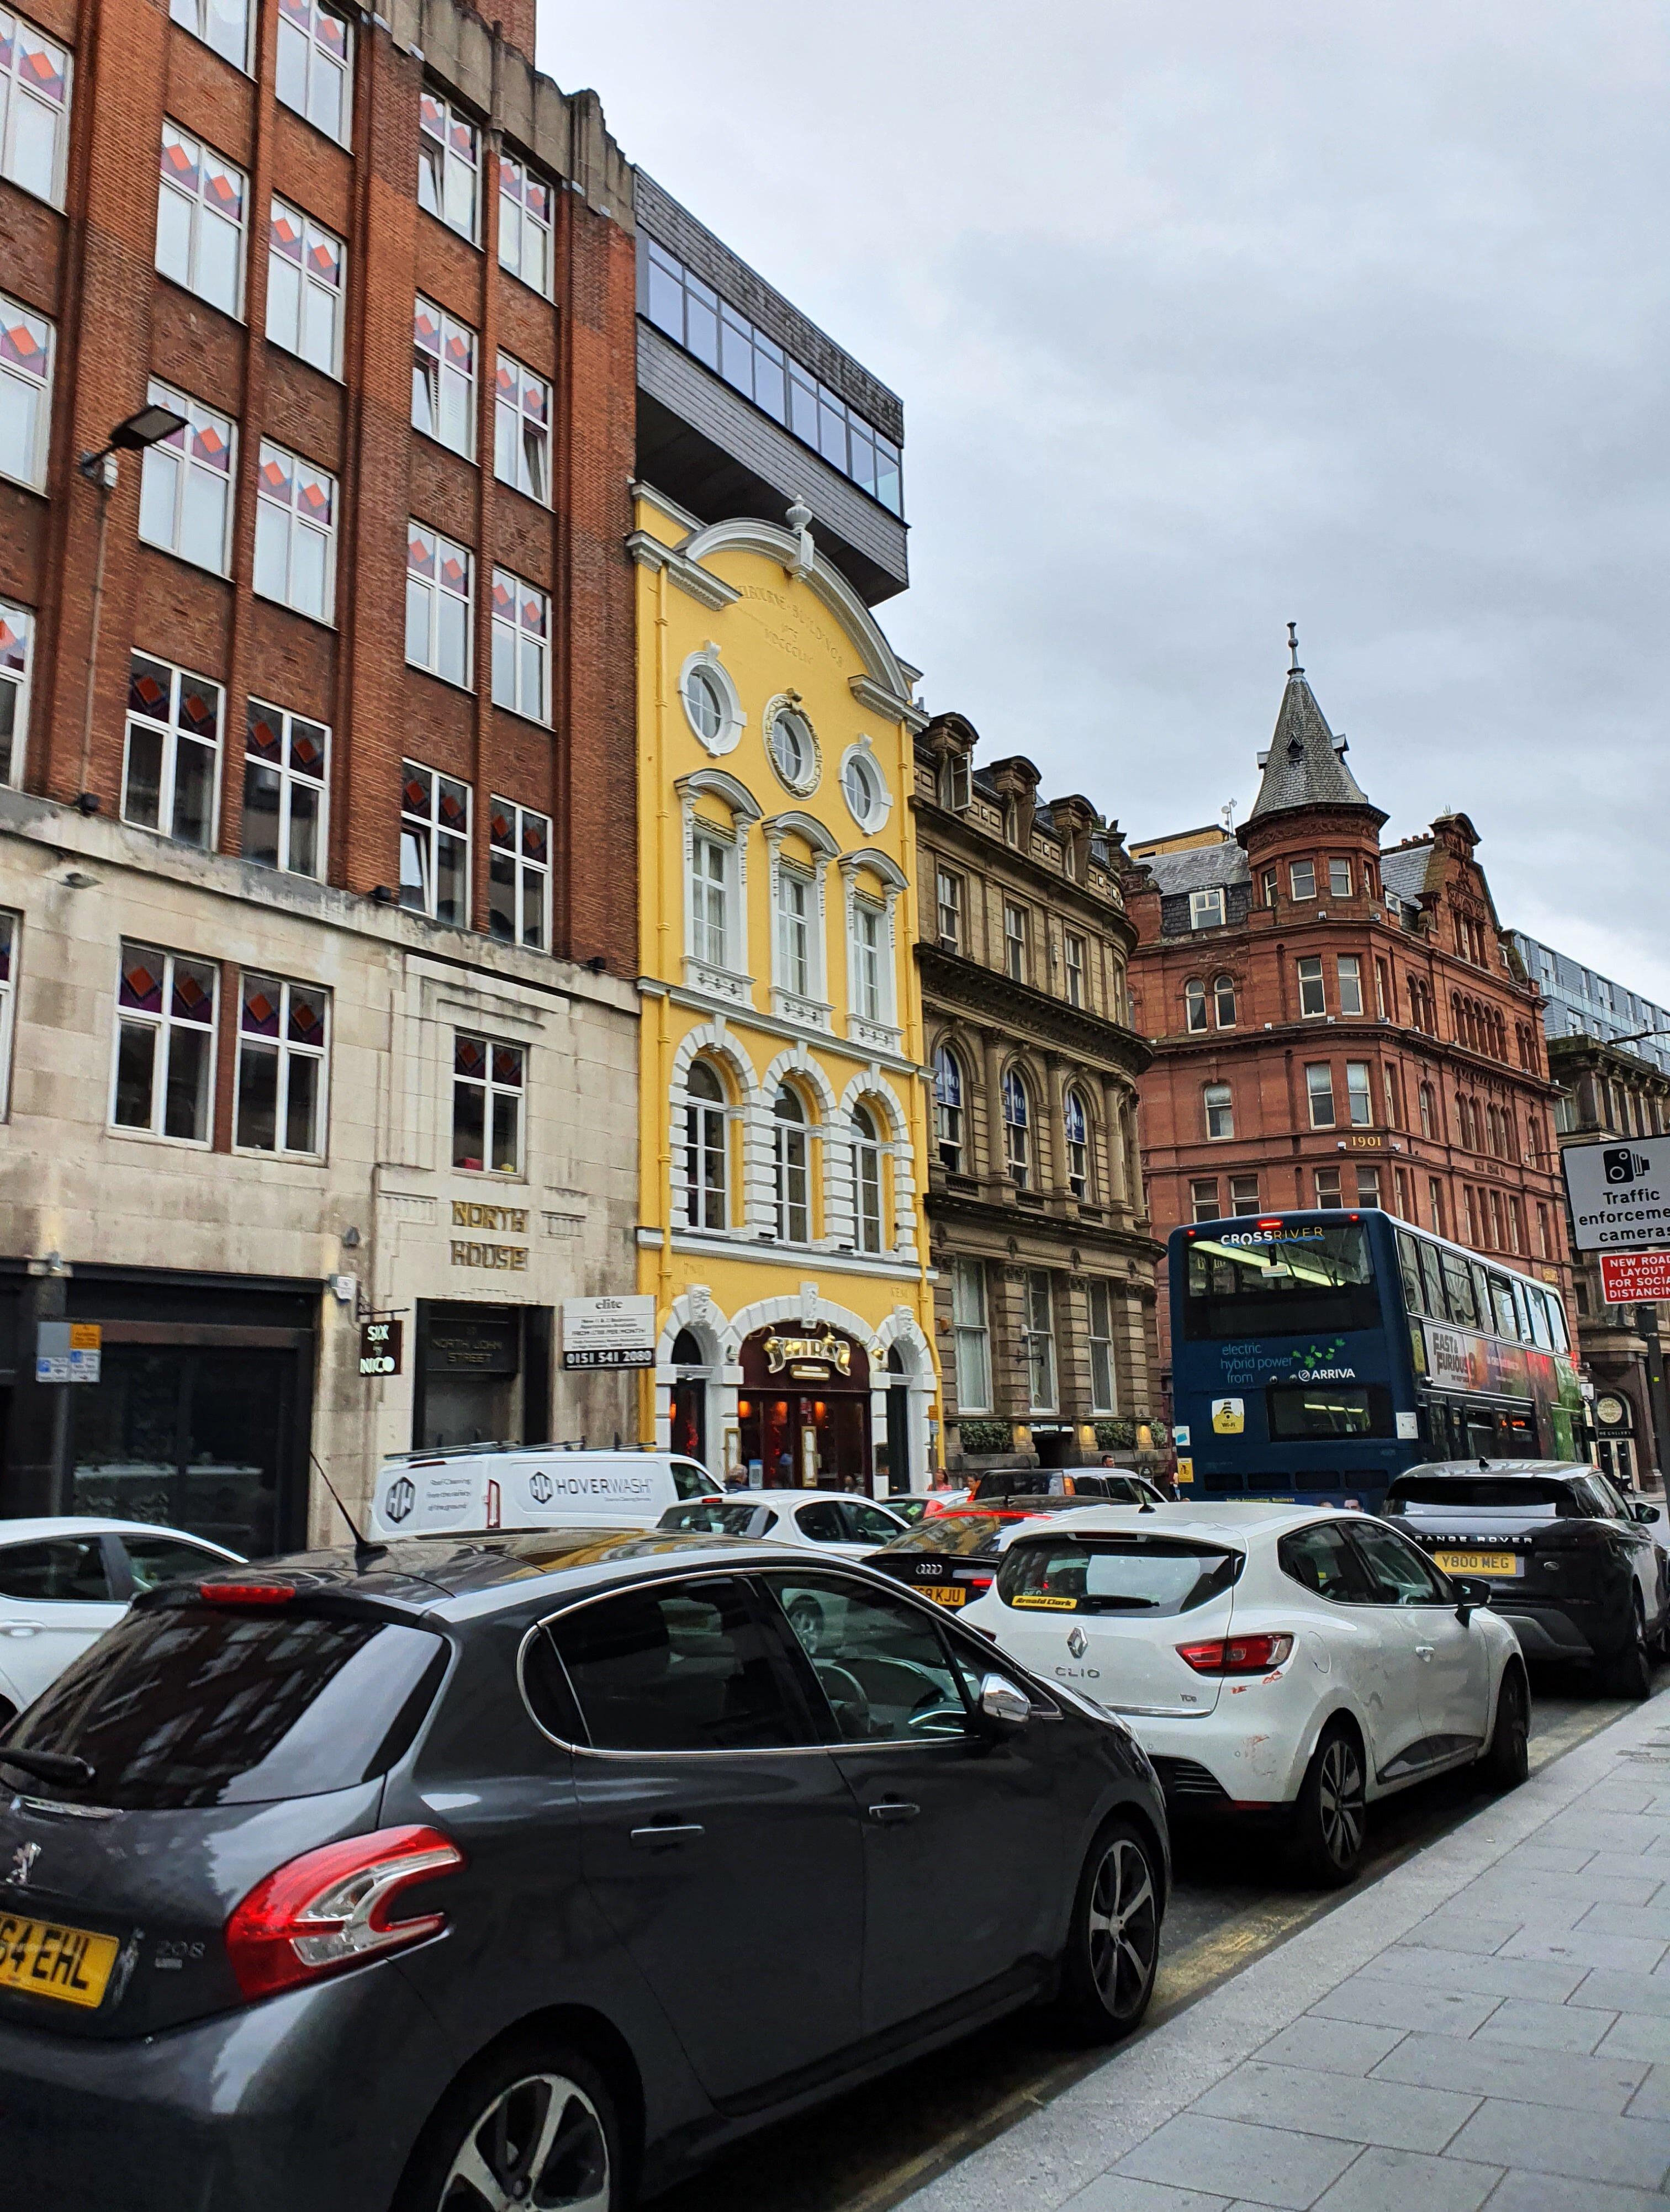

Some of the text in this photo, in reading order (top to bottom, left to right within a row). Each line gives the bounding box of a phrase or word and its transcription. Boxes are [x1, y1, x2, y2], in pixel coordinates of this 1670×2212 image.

[1352, 1136, 1381, 1147] 1901
[1603, 1188, 1660, 1205] Traffic
[452, 1201, 527, 1232] NORTH
[451, 1241, 528, 1271] HOUSE
[1610, 1257, 1636, 1267] NEW
[1620, 1266, 1664, 1277] LAYOUT
[1609, 1278, 1631, 1288] FOR
[367, 1325, 389, 1341] SIX
[1222, 1342, 1262, 1355] electric
[360, 1356, 395, 1374] NICO
[567, 1353, 594, 1364] 0151
[598, 1352, 619, 1363] 541
[1220, 1357, 1293, 1374] hybrid power
[1227, 1368, 1356, 1384] from ARRIVA
[556, 1478, 652, 1495] HOVERWASH
[936, 1589, 960, 1602] KJU
[1055, 1666, 1101, 1678] CLIO
[31, 1929, 90, 1991] EHL
